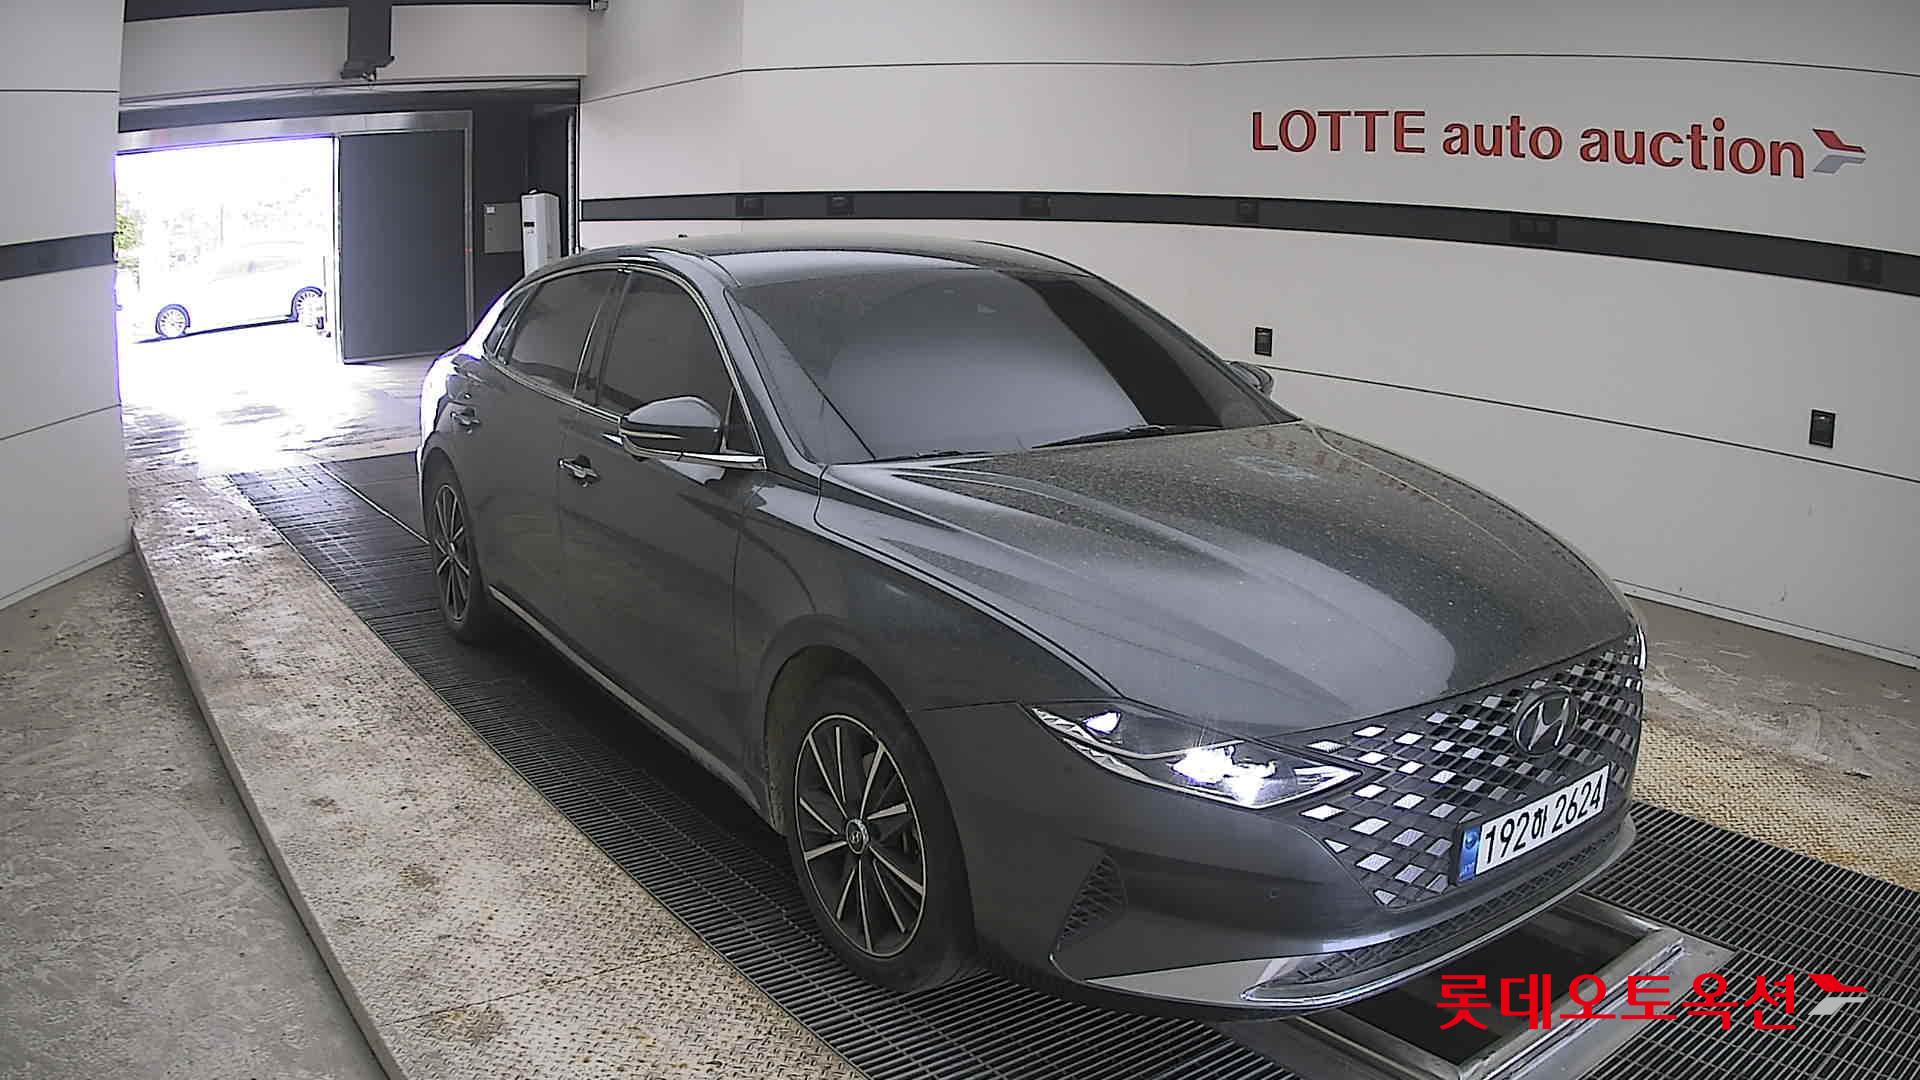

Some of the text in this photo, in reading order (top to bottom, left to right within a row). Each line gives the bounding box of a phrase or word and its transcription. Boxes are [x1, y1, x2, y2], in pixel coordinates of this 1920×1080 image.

[1252, 110, 1805, 179] LOTTE auto auction
[1552, 774, 1603, 834] 2624
